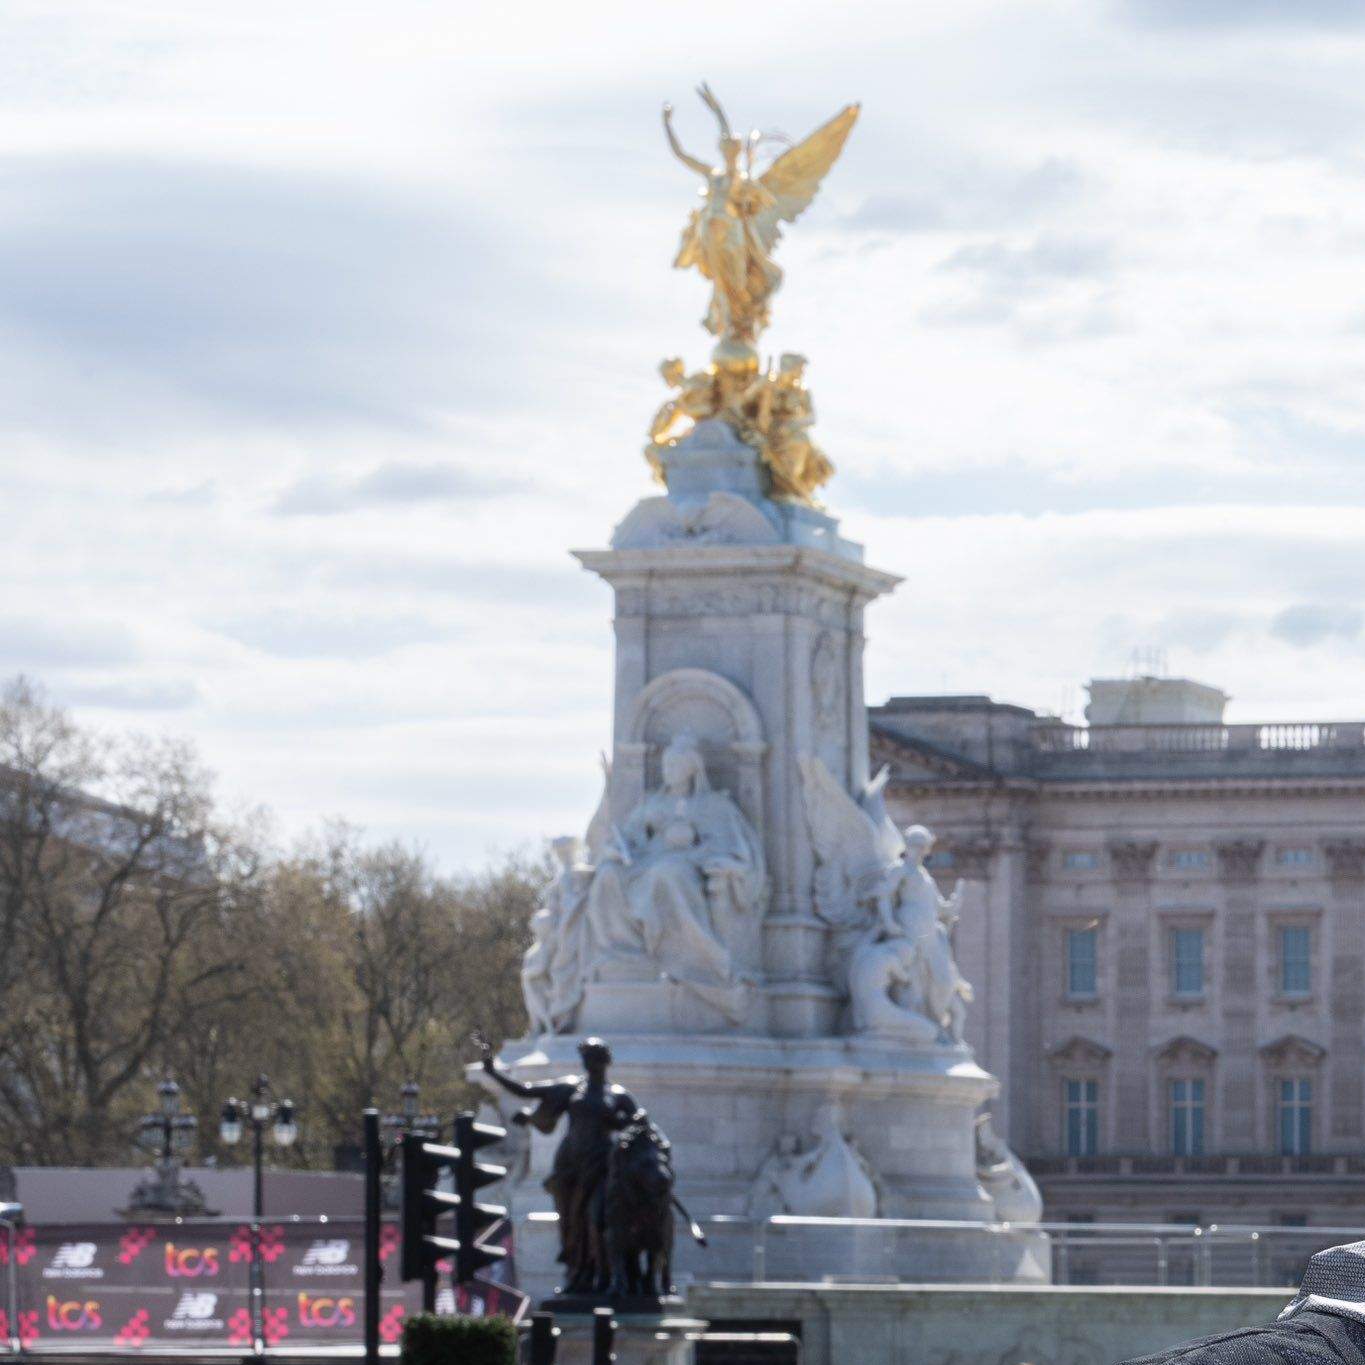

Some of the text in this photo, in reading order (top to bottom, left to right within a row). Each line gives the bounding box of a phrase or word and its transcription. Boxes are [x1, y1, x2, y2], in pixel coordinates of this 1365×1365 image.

[165, 1242, 219, 1277] tcs
[47, 1295, 102, 1330] tcs
[298, 1292, 356, 1327] tcs
